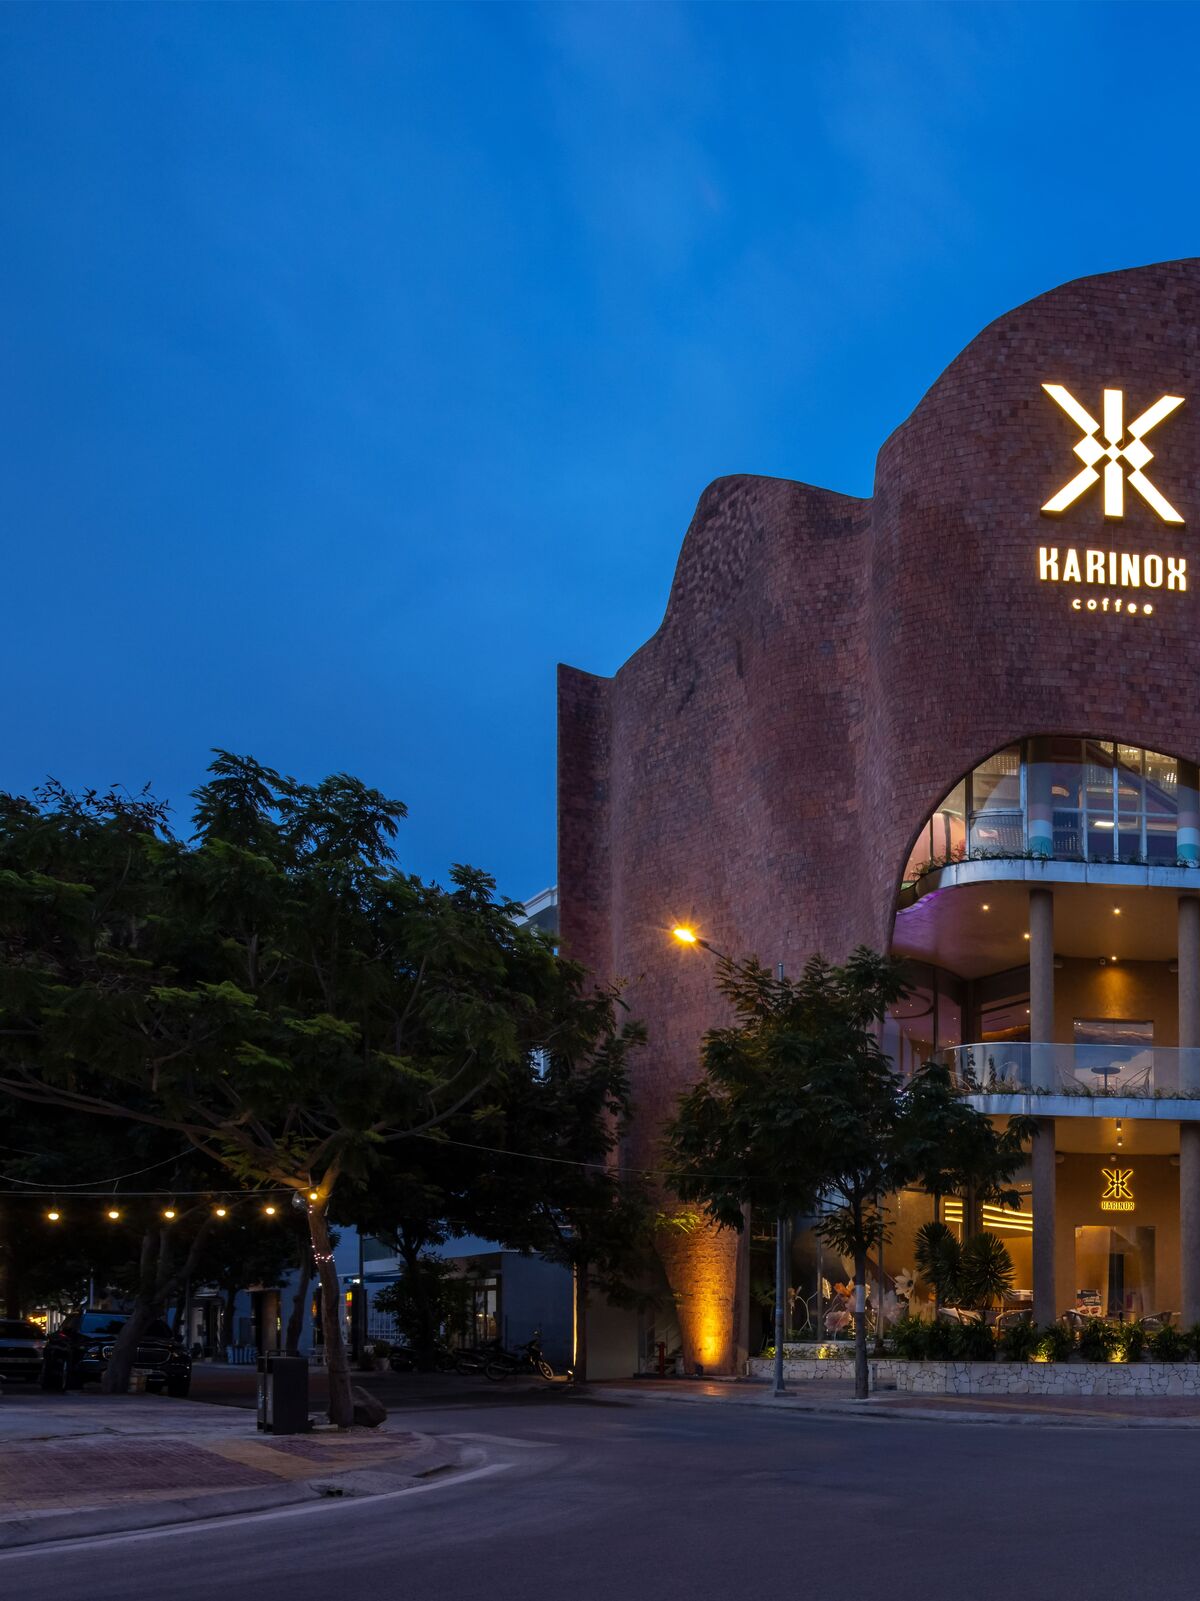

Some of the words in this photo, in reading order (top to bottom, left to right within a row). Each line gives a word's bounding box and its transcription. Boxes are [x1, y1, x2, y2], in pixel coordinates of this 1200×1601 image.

[1039, 546, 1187, 591] KARINOX
[1072, 597, 1154, 615] coffee
[1101, 1201, 1135, 1211] KARINOX
